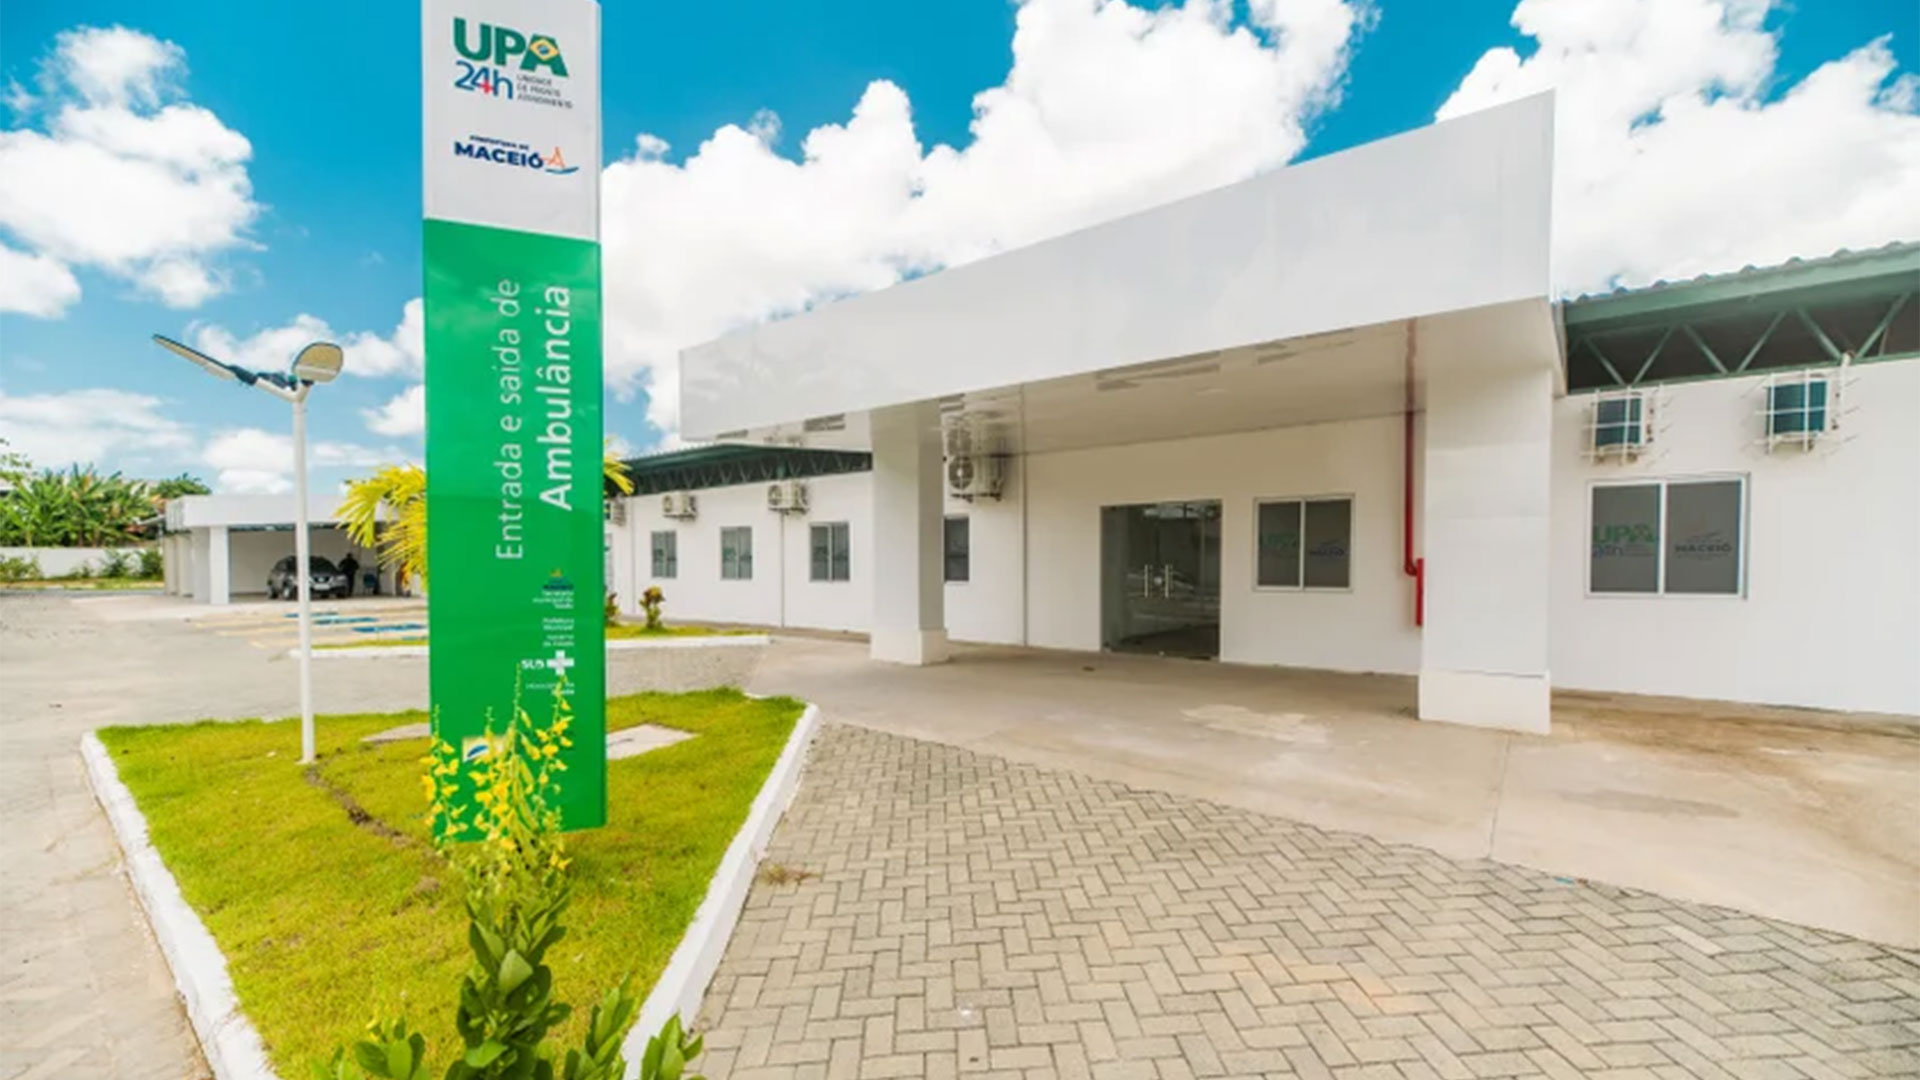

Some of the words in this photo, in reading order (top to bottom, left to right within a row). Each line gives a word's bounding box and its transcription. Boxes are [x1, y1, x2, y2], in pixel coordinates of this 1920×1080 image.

[453, 17, 569, 78] UPA
[454, 60, 514, 100] 24h
[454, 141, 544, 169] MACEIÓ
[491, 279, 520, 317] de
[492, 328, 521, 405] saída
[534, 285, 572, 511] Ambulância
[500, 415, 522, 432] e
[494, 443, 523, 559] Entrada
